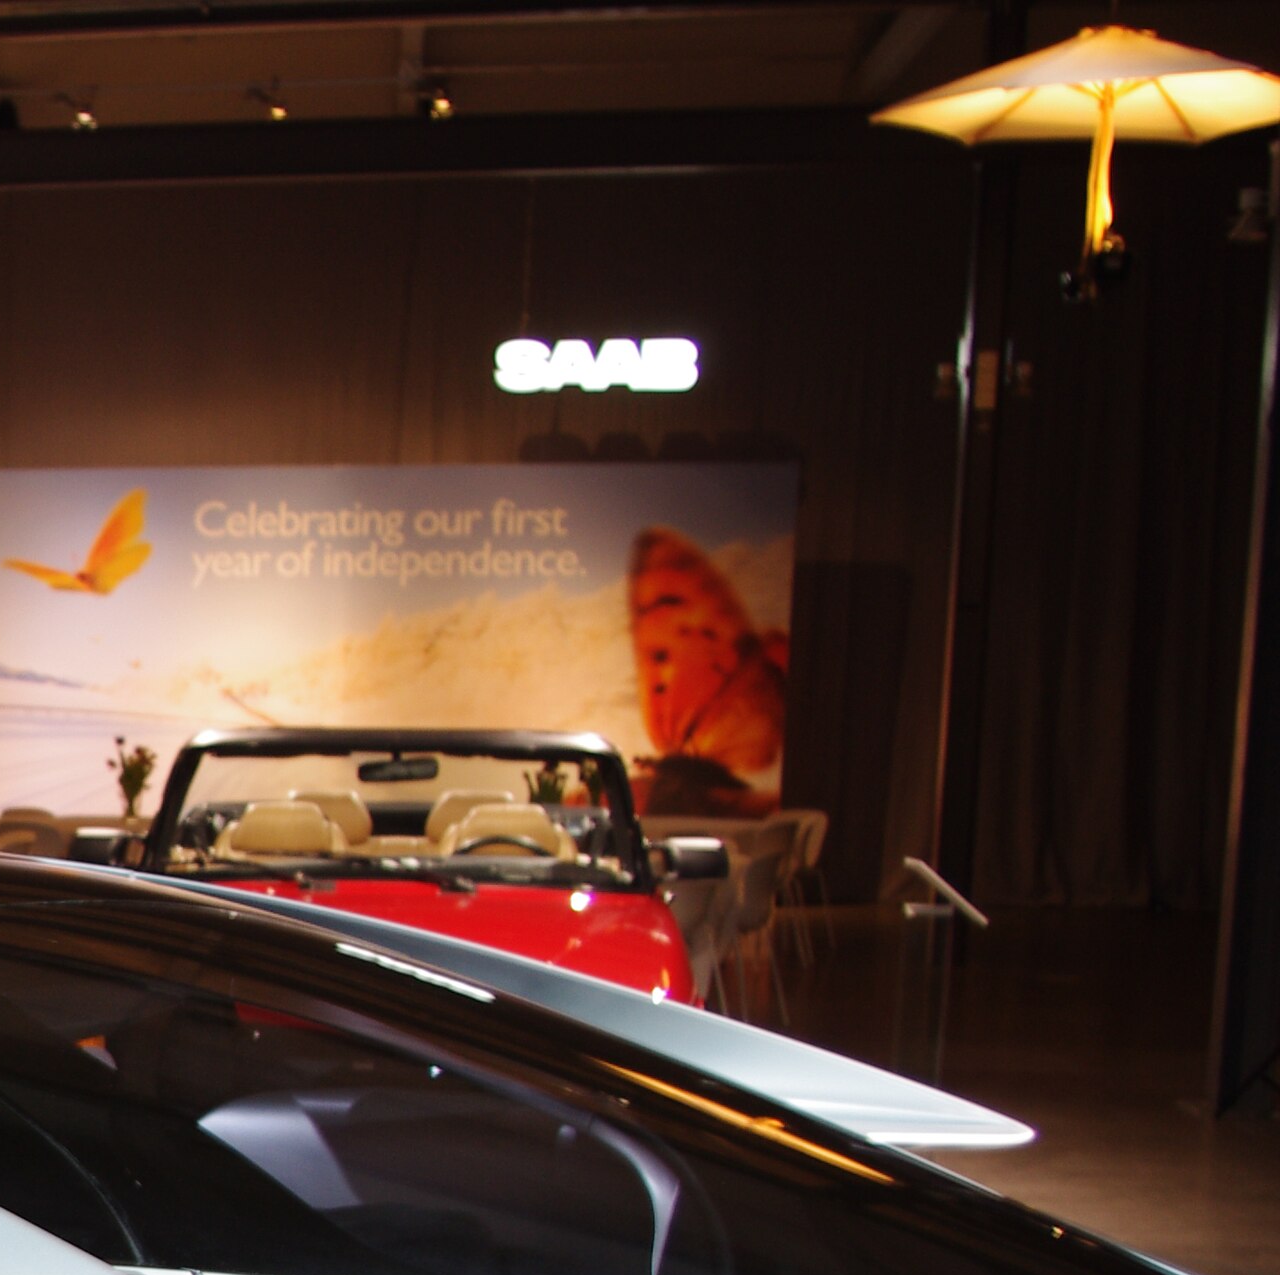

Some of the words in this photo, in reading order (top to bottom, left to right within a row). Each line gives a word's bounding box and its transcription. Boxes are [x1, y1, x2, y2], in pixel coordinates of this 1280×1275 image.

[493, 337, 699, 392] SAAB
[194, 500, 405, 547] Celebrating
[413, 509, 483, 537] our
[492, 498, 568, 537] first
[192, 550, 271, 589] year
[276, 540, 317, 577] of
[323, 541, 587, 587] independence.
